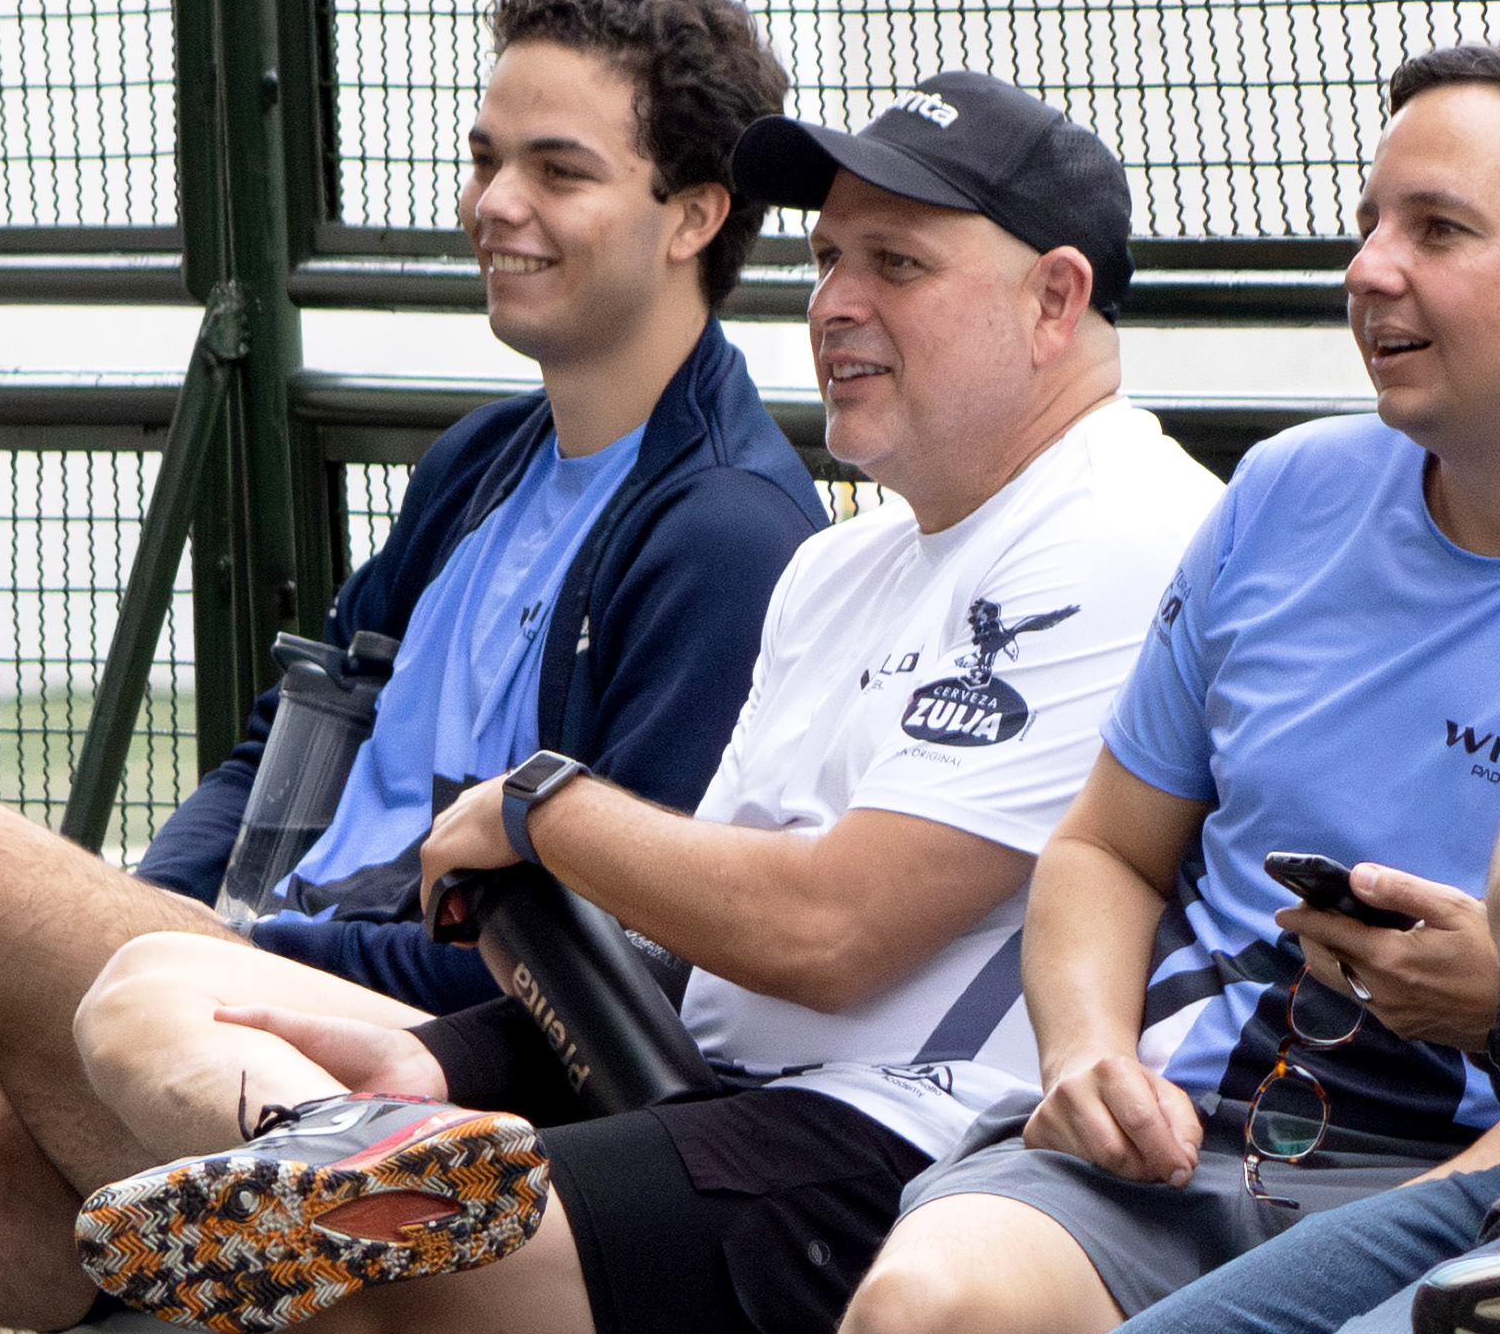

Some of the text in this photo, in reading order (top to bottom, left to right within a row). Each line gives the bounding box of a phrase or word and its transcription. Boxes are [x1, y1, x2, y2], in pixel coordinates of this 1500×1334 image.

[933, 685, 997, 709] CERVEZA
[904, 697, 1002, 742] ZULIA
[911, 747, 963, 767] ORIGINAL
